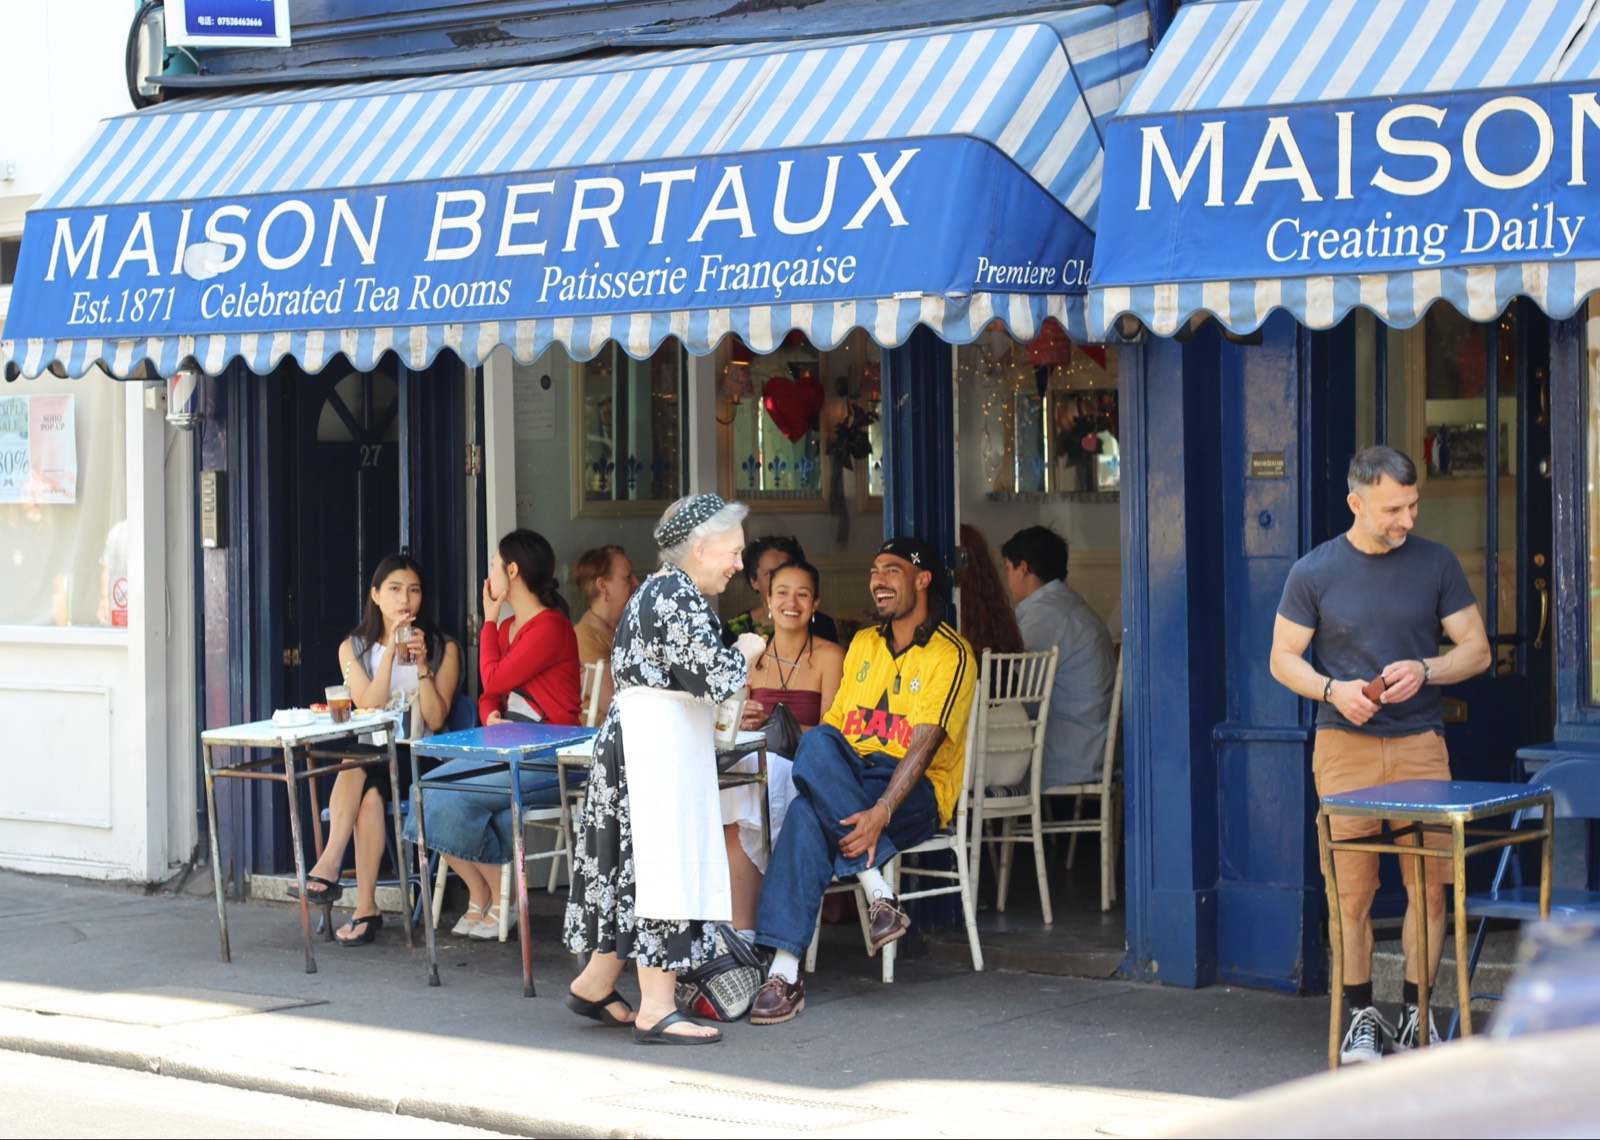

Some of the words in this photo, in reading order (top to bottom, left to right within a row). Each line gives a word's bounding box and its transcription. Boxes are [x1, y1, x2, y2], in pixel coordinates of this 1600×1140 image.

[44, 195, 388, 281] MAISON
[423, 148, 921, 262] BERTAUX
[1266, 211, 1449, 266] Creating
[1460, 201, 1586, 257] Daily
[200, 277, 346, 319] Celebrated
[353, 277, 400, 312] Tea
[407, 275, 512, 310] Rooms
[536, 256, 688, 303] Patisserie
[694, 245, 857, 299] Française
[974, 256, 1057, 285] Premiere
[42, 414, 63, 422] SOHO
[360, 444, 382, 466] 27
